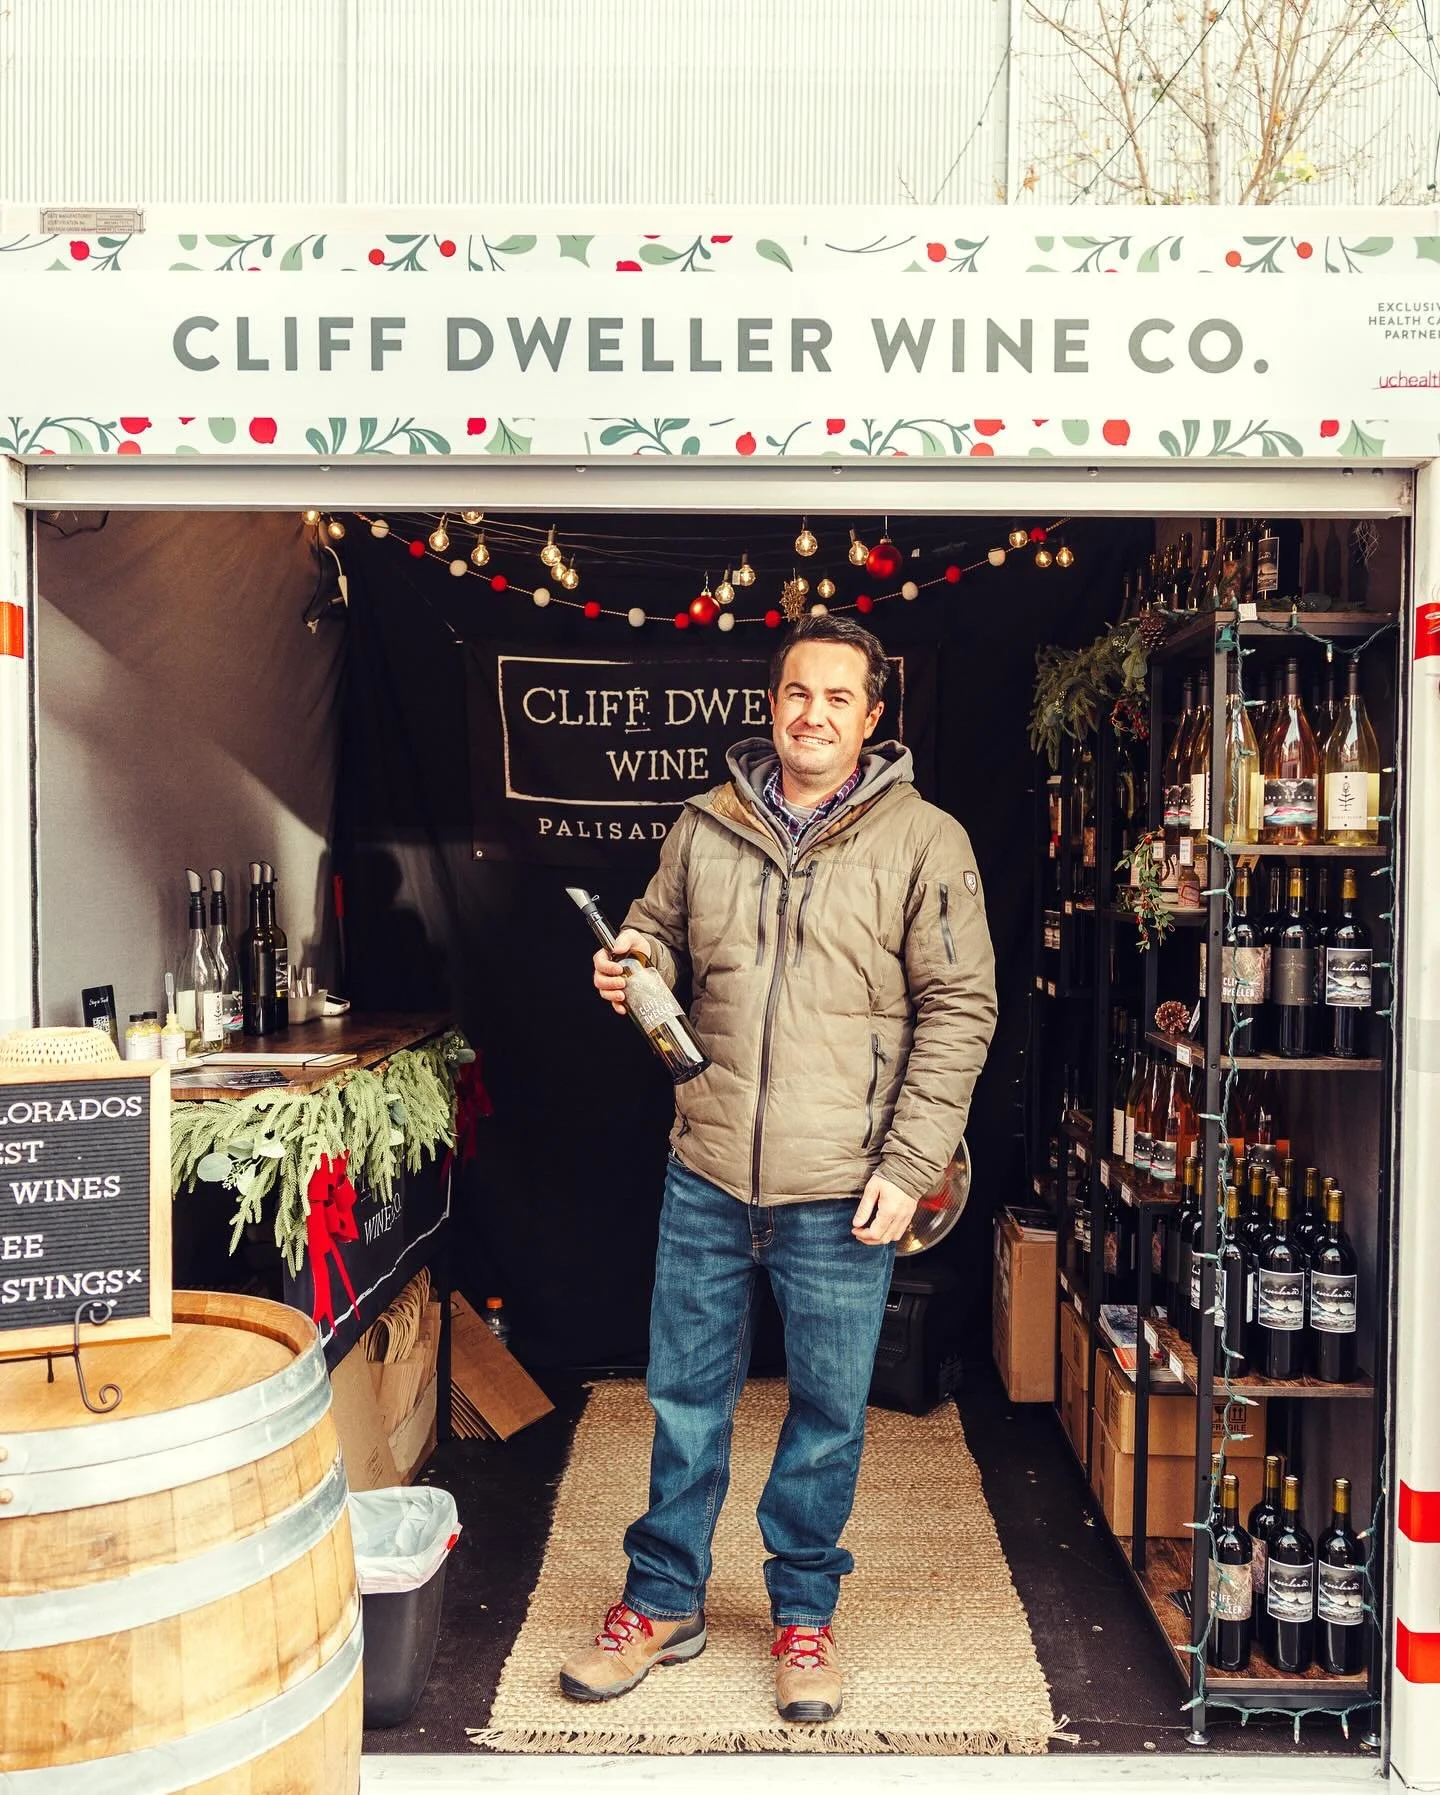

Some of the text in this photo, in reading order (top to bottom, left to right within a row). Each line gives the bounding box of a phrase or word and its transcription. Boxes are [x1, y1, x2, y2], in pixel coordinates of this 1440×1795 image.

[1368, 316, 1421, 326] HEALTH
[172, 315, 1270, 374] CLIFF DWELLER WINE CO.
[1385, 329, 1440, 340] PARTNE
[1378, 369, 1440, 389] uchealt
[522, 686, 773, 727] CLIFF DWE
[606, 747, 709, 782] WINE
[539, 817, 677, 840] PALISAD
[0, 1141, 44, 1164] ST
[10, 1176, 121, 1205] WINES
[363, 1204, 392, 1246] WINE
[1210, 1590, 1232, 1604] CIFF
[1210, 1600, 1243, 1615] DLLER
